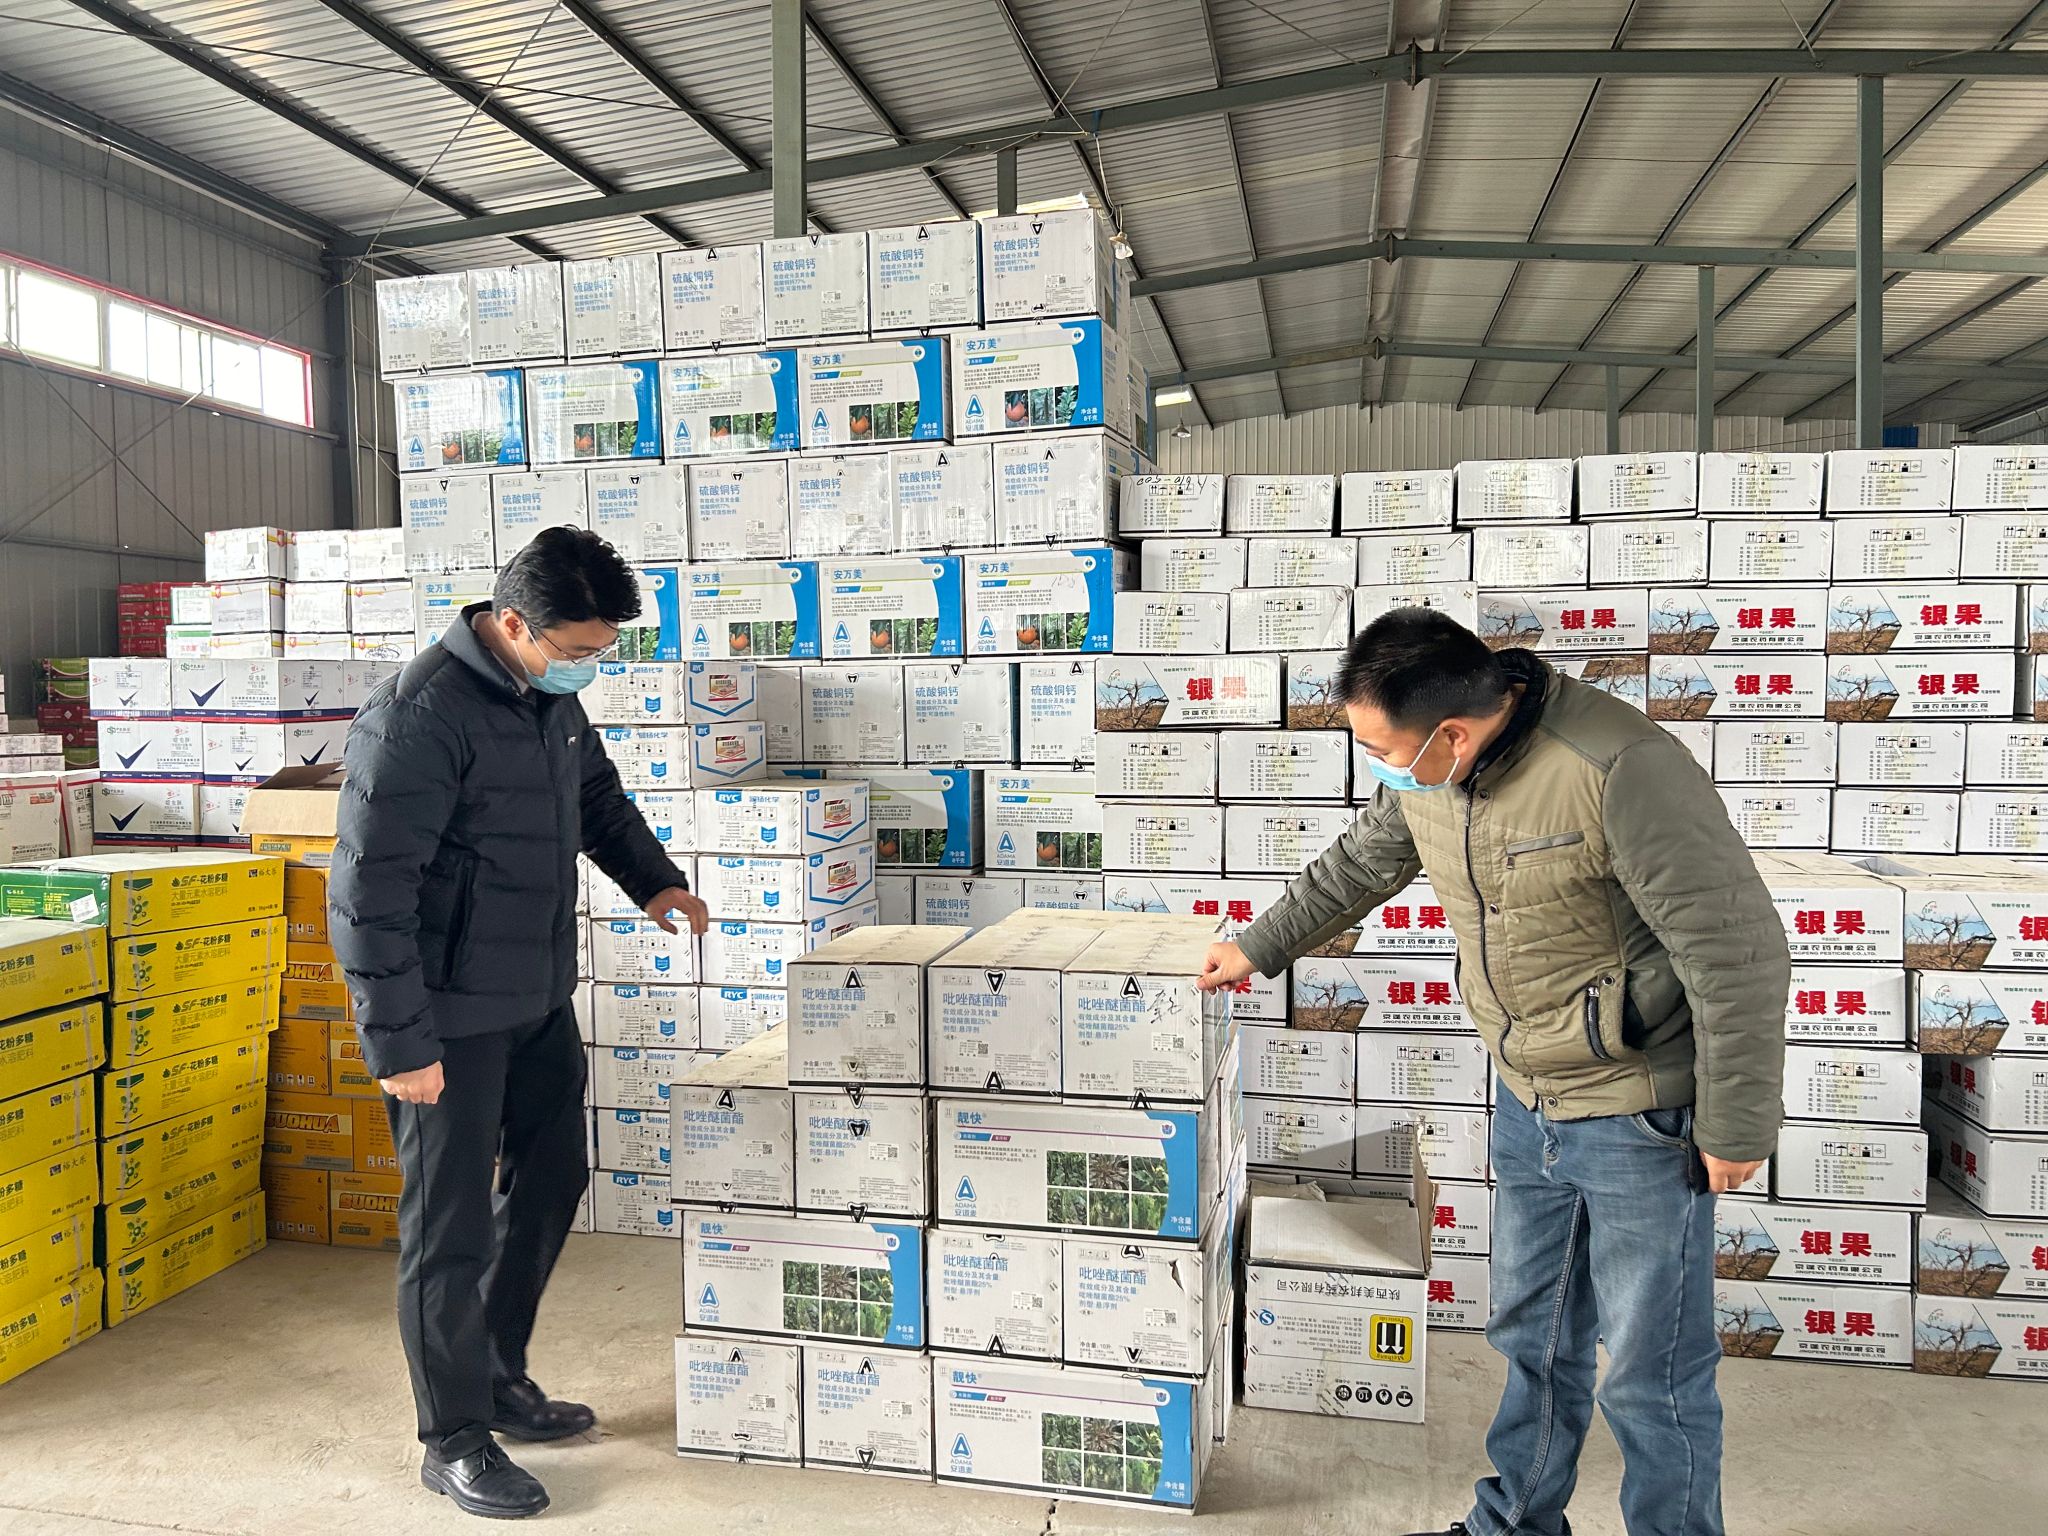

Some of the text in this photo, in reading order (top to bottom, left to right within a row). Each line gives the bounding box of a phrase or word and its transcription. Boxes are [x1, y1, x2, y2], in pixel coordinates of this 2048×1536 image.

[993, 237, 1041, 252] 硫酸铜钙
[880, 247, 926, 263] 硫酸铜钙
[773, 257, 817, 273] 硫酸铜钙
[966, 338, 997, 351] 安万美
[812, 354, 842, 367] 安万美
[1004, 461, 1050, 475] 硫酸铜钙
[898, 470, 943, 483] 硫酸铜钙
[699, 484, 741, 496] 硫酸铜钙
[799, 478, 841, 490] 硫酸铜钙
[502, 491, 542, 505] 硫酸铜钙
[597, 487, 639, 501] 硫酸铜钙
[409, 497, 449, 510] 硫酸铜钙
[833, 569, 863, 580] 安万美
[979, 562, 1010, 574] 安万美
[692, 573, 721, 584] 安万美
[426, 583, 453, 594] 安万美
[1561, 608, 1616, 630] 银果
[1737, 608, 1795, 629] 银果
[1920, 604, 1982, 626] 银果
[602, 664, 624, 674] RYC
[1030, 683, 1077, 697] 硫酸铜钙
[1185, 677, 1248, 701] 银果
[1735, 674, 1792, 695] 银果
[1918, 674, 1979, 695] 银果
[812, 686, 855, 700] 硫酸铜钙
[915, 685, 960, 699] 硫酸铜钙
[608, 732, 630, 740] RYC
[1000, 778, 1031, 791] 安万美
[718, 794, 742, 804] RYC
[721, 858, 744, 868] RYC
[181, 872, 228, 886] SF-花粉多糖
[925, 897, 971, 911] 硫酸铜钙
[1382, 906, 1446, 929] 银果
[1795, 910, 1865, 935] 银果
[614, 924, 635, 932] RYC
[724, 925, 746, 934] RYC
[184, 934, 231, 950] SF-花粉多糖
[617, 986, 638, 995] RYC
[724, 990, 746, 1000] RYC
[802, 988, 866, 1001] 吡唑醚菌酯
[1388, 981, 1451, 1005] 银果
[181, 994, 228, 1011] SF-花粉多糖
[942, 992, 1008, 1008] 吡唑醚菌酯
[1078, 997, 1146, 1013] 吡唑醚菌酯
[1795, 991, 1867, 1015] 银果
[616, 1048, 638, 1058] RYC
[171, 1056, 218, 1076] SF-花粉多糖
[619, 1113, 639, 1122] RYC
[683, 1110, 744, 1125] 吡唑醚菌酯
[957, 1111, 982, 1125] 靓快
[616, 1176, 636, 1185] RYC
[701, 1222, 724, 1236] 靓快
[1801, 1231, 1872, 1257] 银果
[942, 1253, 1009, 1271] 吡唑醚菌酯
[1079, 1266, 1147, 1285] 吡唑醚菌酯
[1276, 1279, 1400, 1301] 陕西美邦农药有限公司
[1428, 1280, 1454, 1303] 果
[1805, 1310, 1874, 1336] 银果
[689, 1360, 749, 1376] 吡唑醚菌酯
[818, 1369, 880, 1387] 吡唑醚菌酯
[952, 1369, 977, 1385] 靓快
